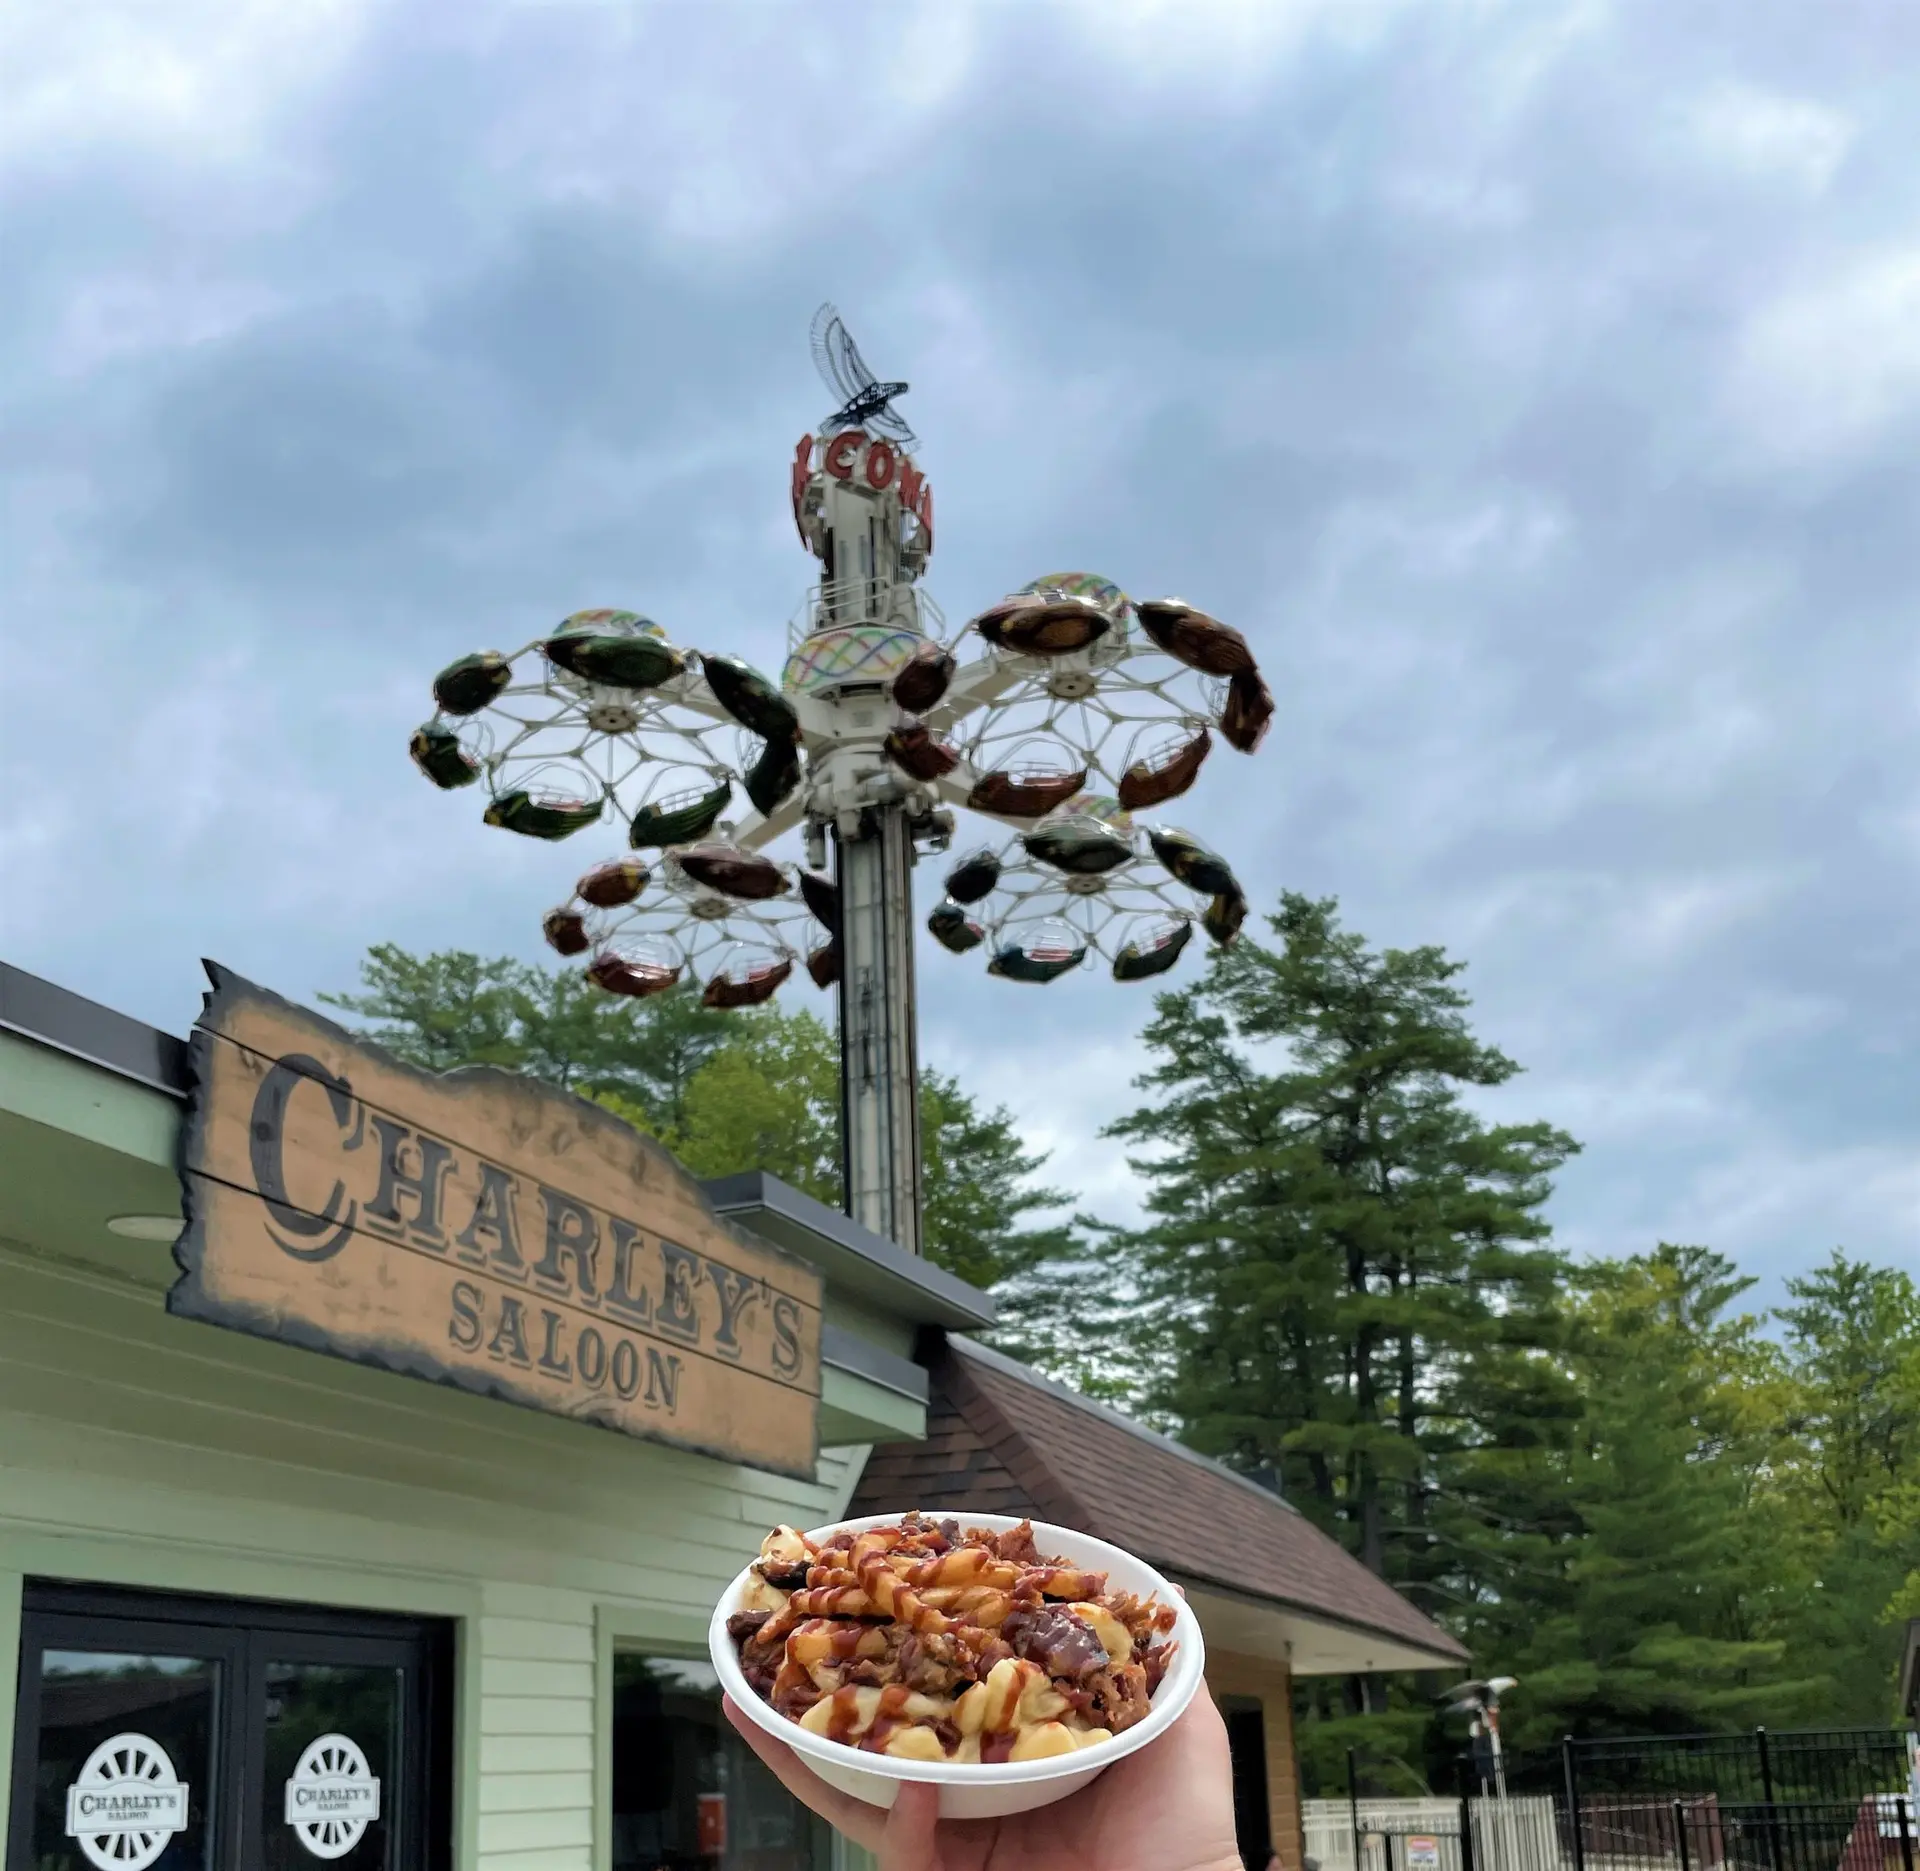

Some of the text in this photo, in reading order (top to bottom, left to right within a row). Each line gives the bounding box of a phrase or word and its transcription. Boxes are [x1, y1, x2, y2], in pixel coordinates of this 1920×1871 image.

[249, 1053, 803, 1380] CHARLEY'S
[449, 1279, 684, 1416] SALOON
[80, 1794, 177, 1816] CHARLEY'S
